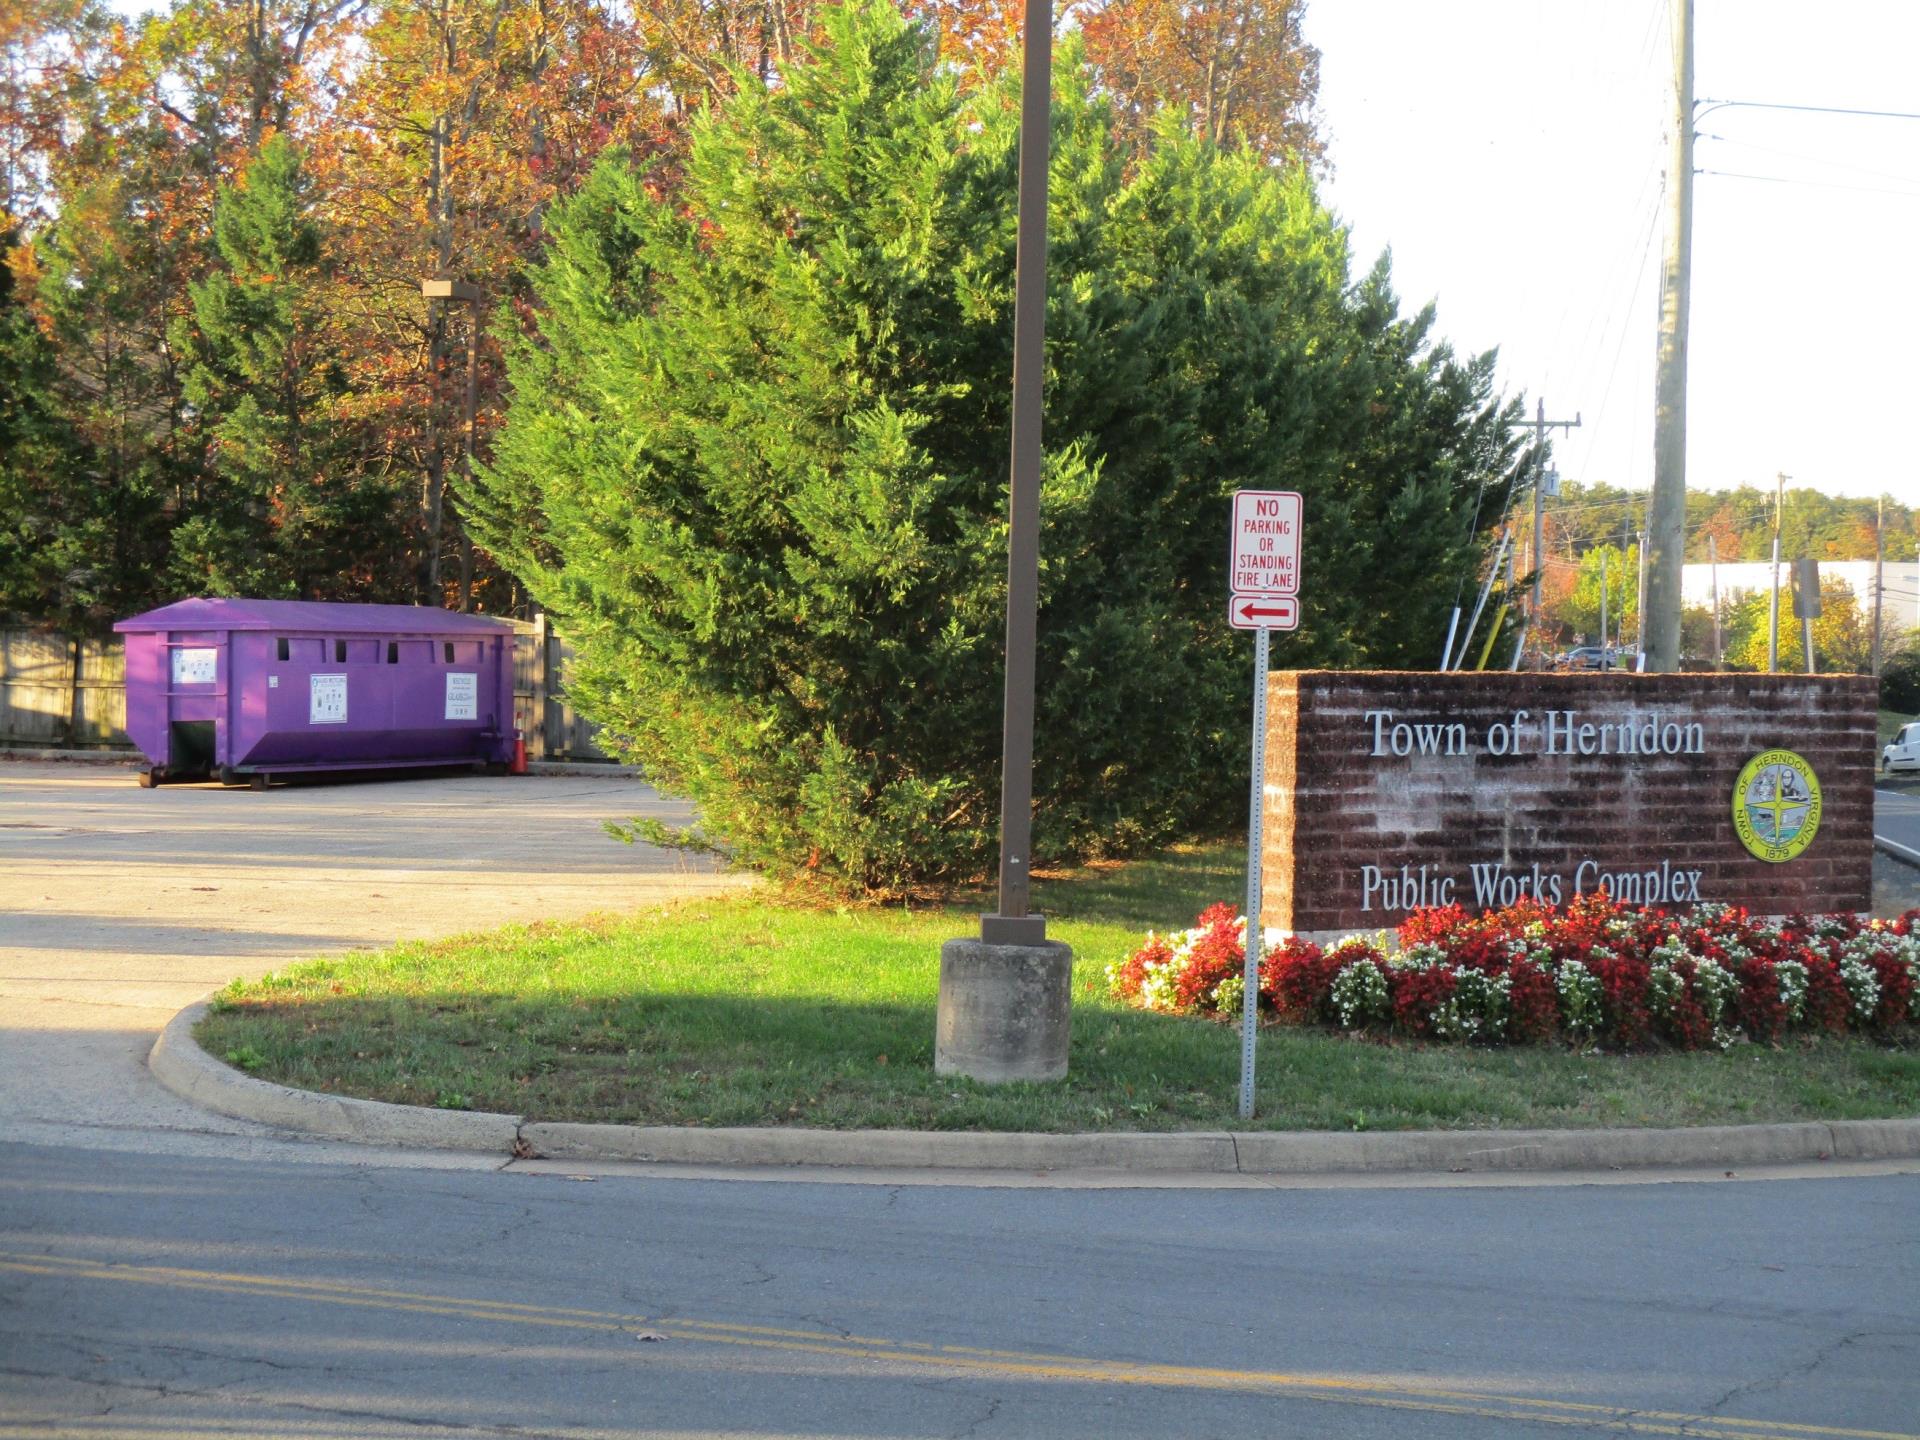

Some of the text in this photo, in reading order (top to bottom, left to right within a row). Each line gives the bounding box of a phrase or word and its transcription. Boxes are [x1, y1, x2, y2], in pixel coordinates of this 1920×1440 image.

[1256, 499, 1279, 517] NO
[1244, 519, 1290, 535] PARKING
[1259, 537, 1274, 551] OR
[1239, 554, 1292, 570] STANDING
[1237, 571, 1293, 588] FIRE LANE
[1364, 710, 1705, 756] Town of Herndon
[1736, 754, 1819, 848] TOWN OF HERNDON VIRGINIA
[1765, 848, 1790, 859] 1879
[1360, 858, 1702, 912] Public Works Complex
